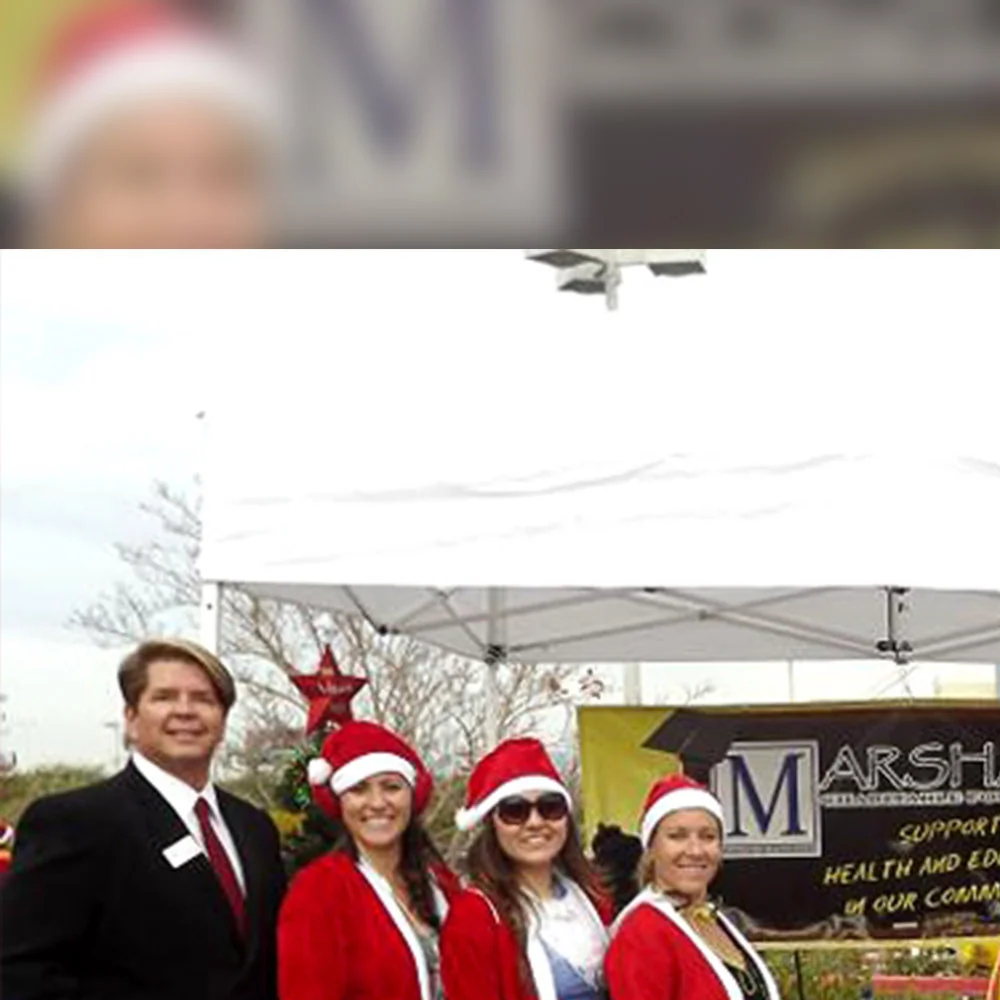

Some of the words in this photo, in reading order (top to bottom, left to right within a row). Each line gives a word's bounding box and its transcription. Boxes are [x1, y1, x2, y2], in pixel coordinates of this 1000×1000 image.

[823, 857, 914, 886] HEALTH
[919, 852, 961, 877] AND
[872, 893, 918, 912] OUR
